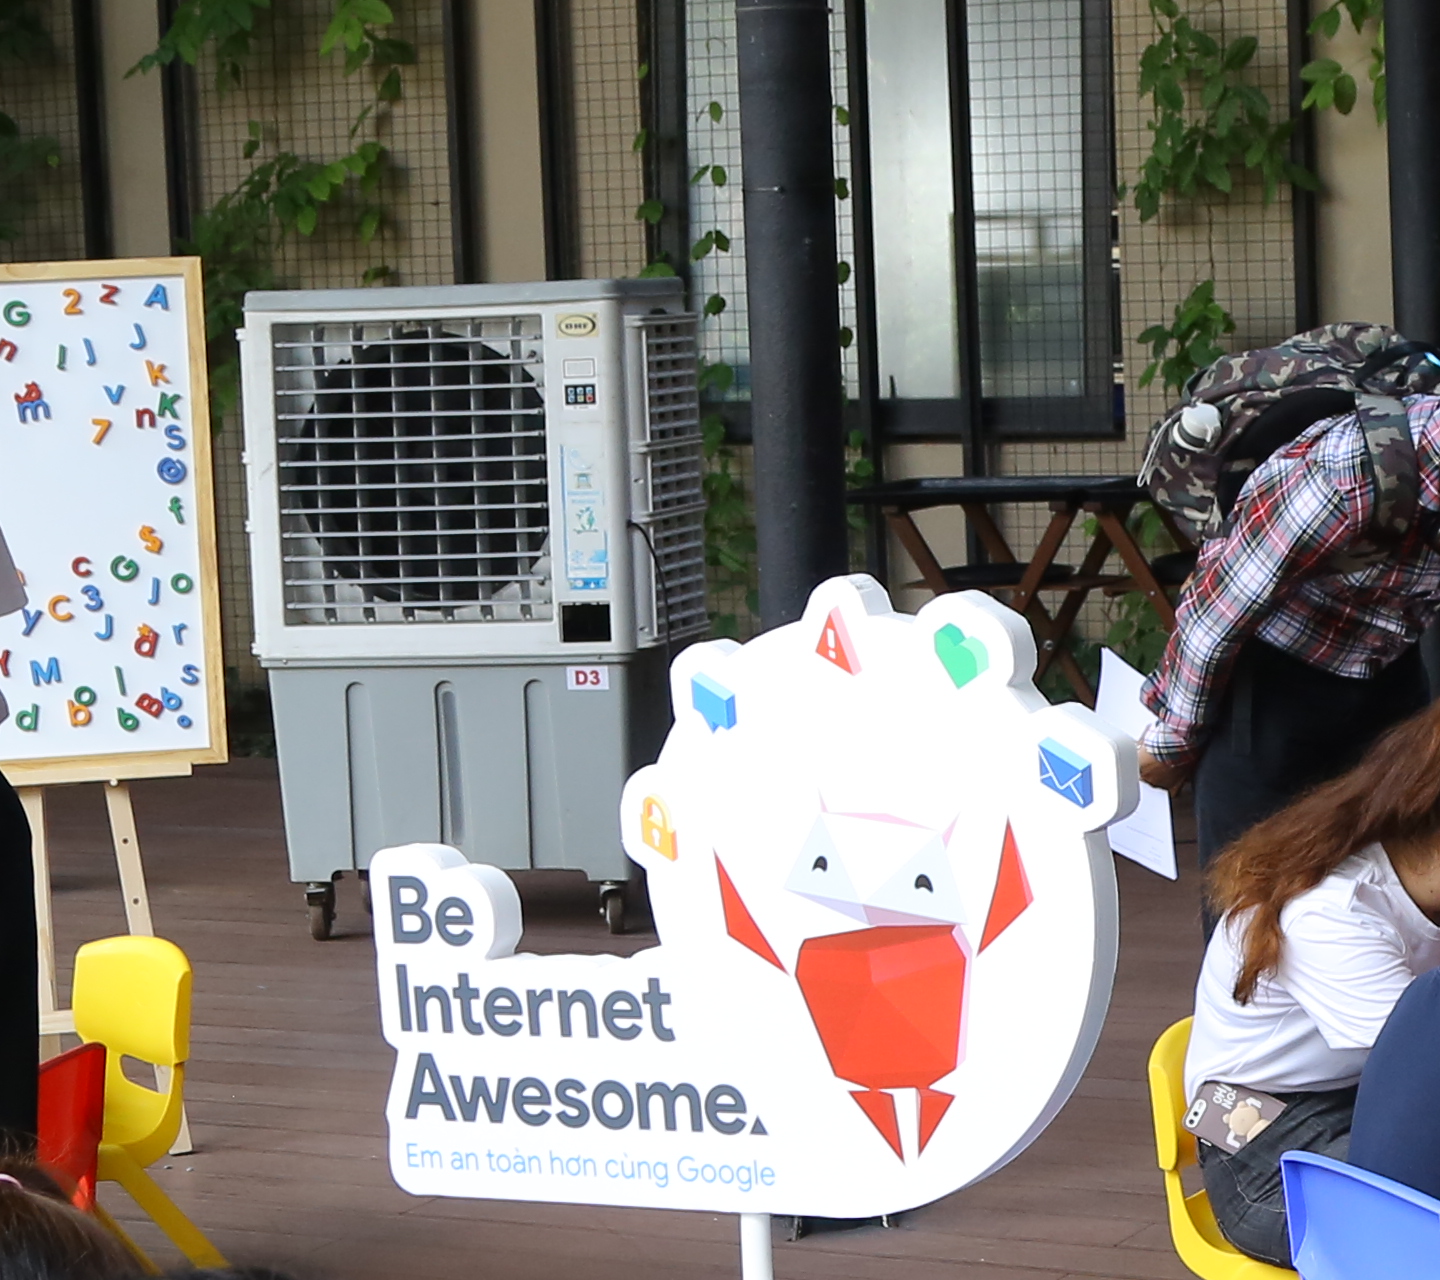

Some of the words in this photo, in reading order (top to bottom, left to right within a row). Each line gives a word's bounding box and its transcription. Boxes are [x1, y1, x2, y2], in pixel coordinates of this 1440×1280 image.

[63, 288, 82, 315] 2
[144, 283, 169, 309] A
[81, 584, 104, 611] 3
[574, 669, 601, 686] D3
[388, 875, 474, 946] Be
[396, 964, 676, 1042] Internet
[406, 1143, 443, 1169] Em
[450, 1150, 479, 1172] an
[487, 1146, 542, 1175] toàn
[550, 1150, 597, 1177] hơn
[605, 1151, 669, 1188] cùng
[676, 1156, 776, 1192] Google
